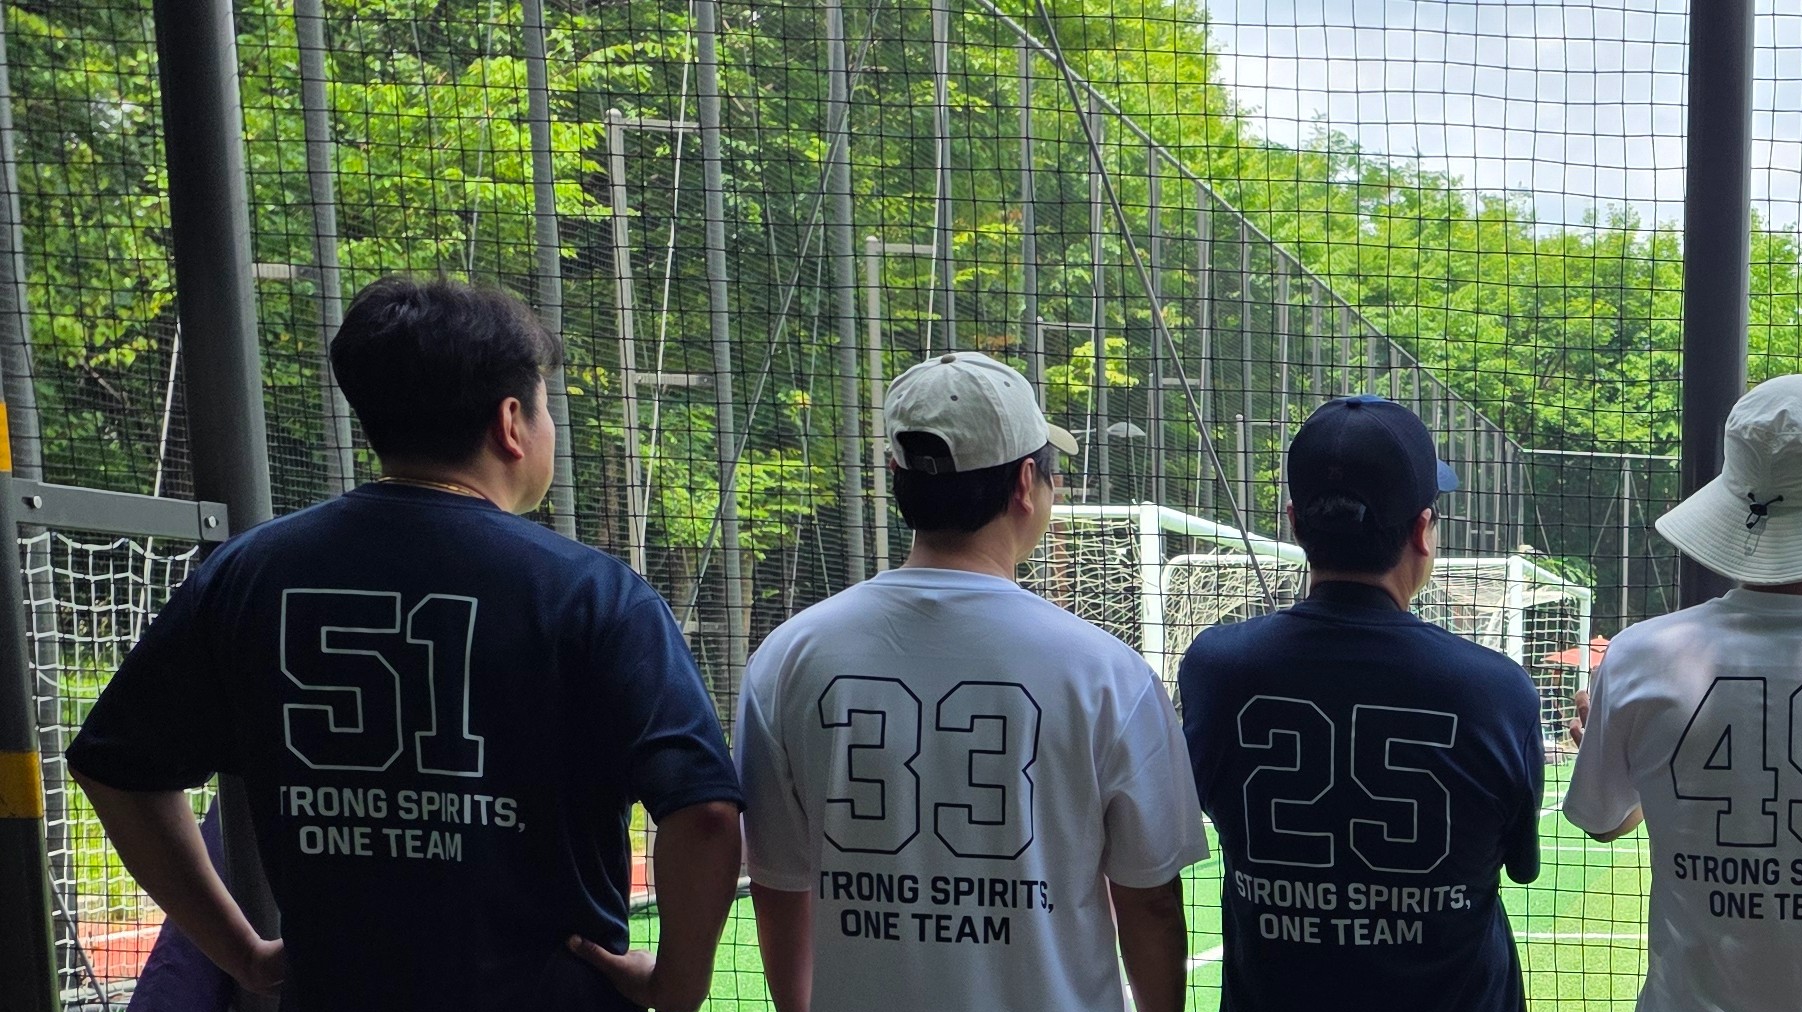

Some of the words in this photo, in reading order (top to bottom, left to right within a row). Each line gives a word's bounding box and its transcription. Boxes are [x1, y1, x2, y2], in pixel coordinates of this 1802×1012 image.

[280, 588, 485, 777] 51
[818, 674, 1043, 861] 33
[1237, 694, 1458, 874] 25
[280, 786, 388, 819] TRONG
[397, 790, 526, 833] SPIRITS,
[299, 825, 373, 856] ONE
[382, 828, 462, 862] TEAM
[1674, 853, 1780, 886] STRONG
[819, 871, 919, 904] TRONG
[931, 876, 1054, 913] SPIRITS,
[1235, 870, 1337, 911] STRONG
[1348, 883, 1471, 914] SPIRITS,
[1709, 890, 1764, 919] ONE
[840, 909, 900, 941] ONE
[911, 913, 1010, 945] TEAM
[1259, 913, 1321, 944] ONE
[1331, 918, 1423, 946] TEAM
